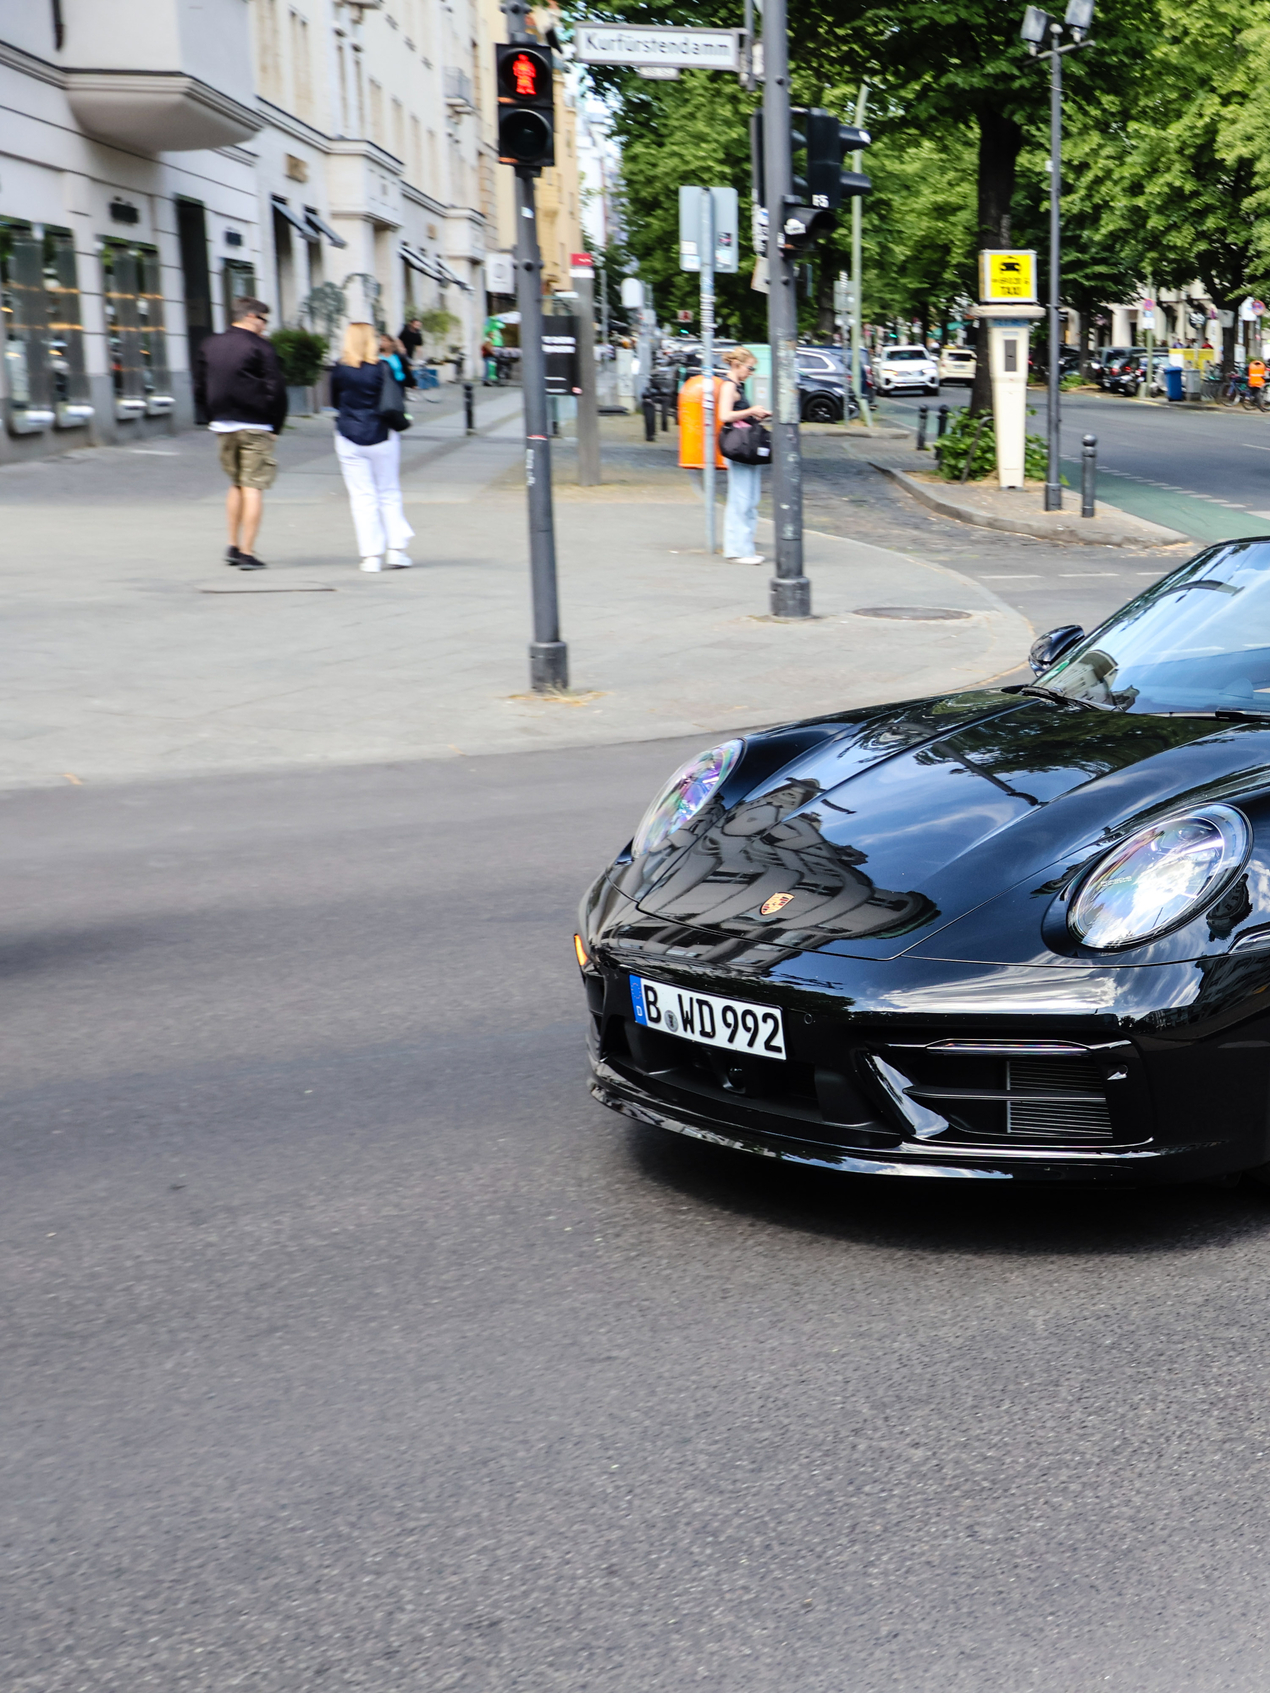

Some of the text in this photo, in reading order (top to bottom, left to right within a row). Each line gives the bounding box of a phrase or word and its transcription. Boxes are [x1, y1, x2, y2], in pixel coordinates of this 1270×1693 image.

[585, 31, 731, 57] Kurfürstendamm
[1000, 286, 1022, 295] TAXI
[643, 984, 783, 1053] B WD 992
